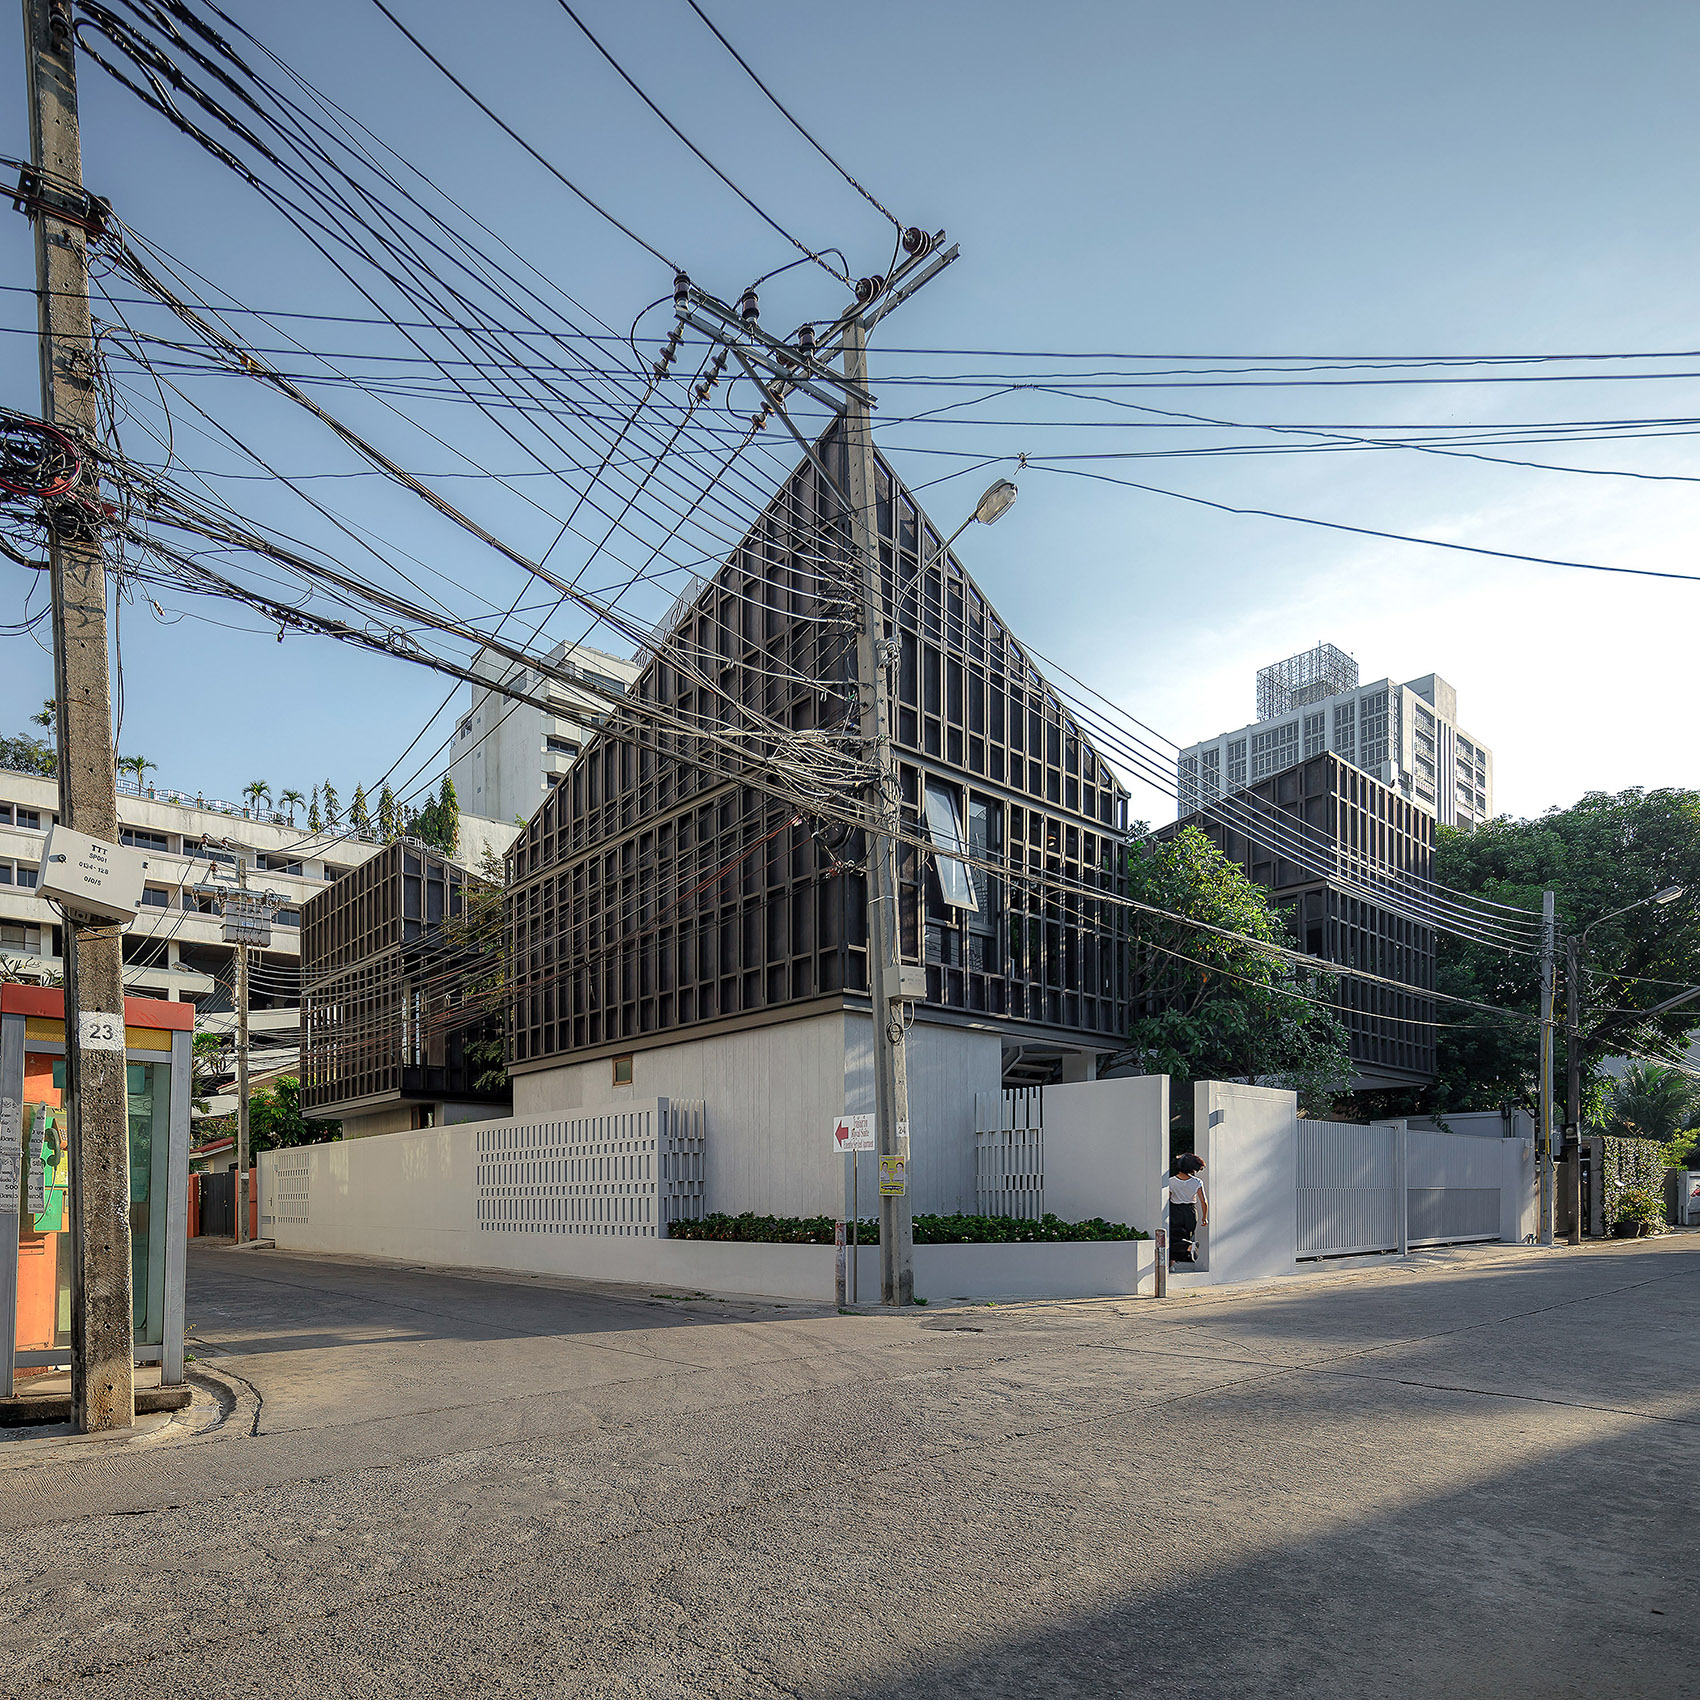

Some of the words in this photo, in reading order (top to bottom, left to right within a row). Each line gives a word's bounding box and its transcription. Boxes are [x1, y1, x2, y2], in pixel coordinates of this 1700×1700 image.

[91, 844, 108, 855] TTT
[89, 1024, 114, 1041] 23
[898, 1125, 906, 1135] 24
